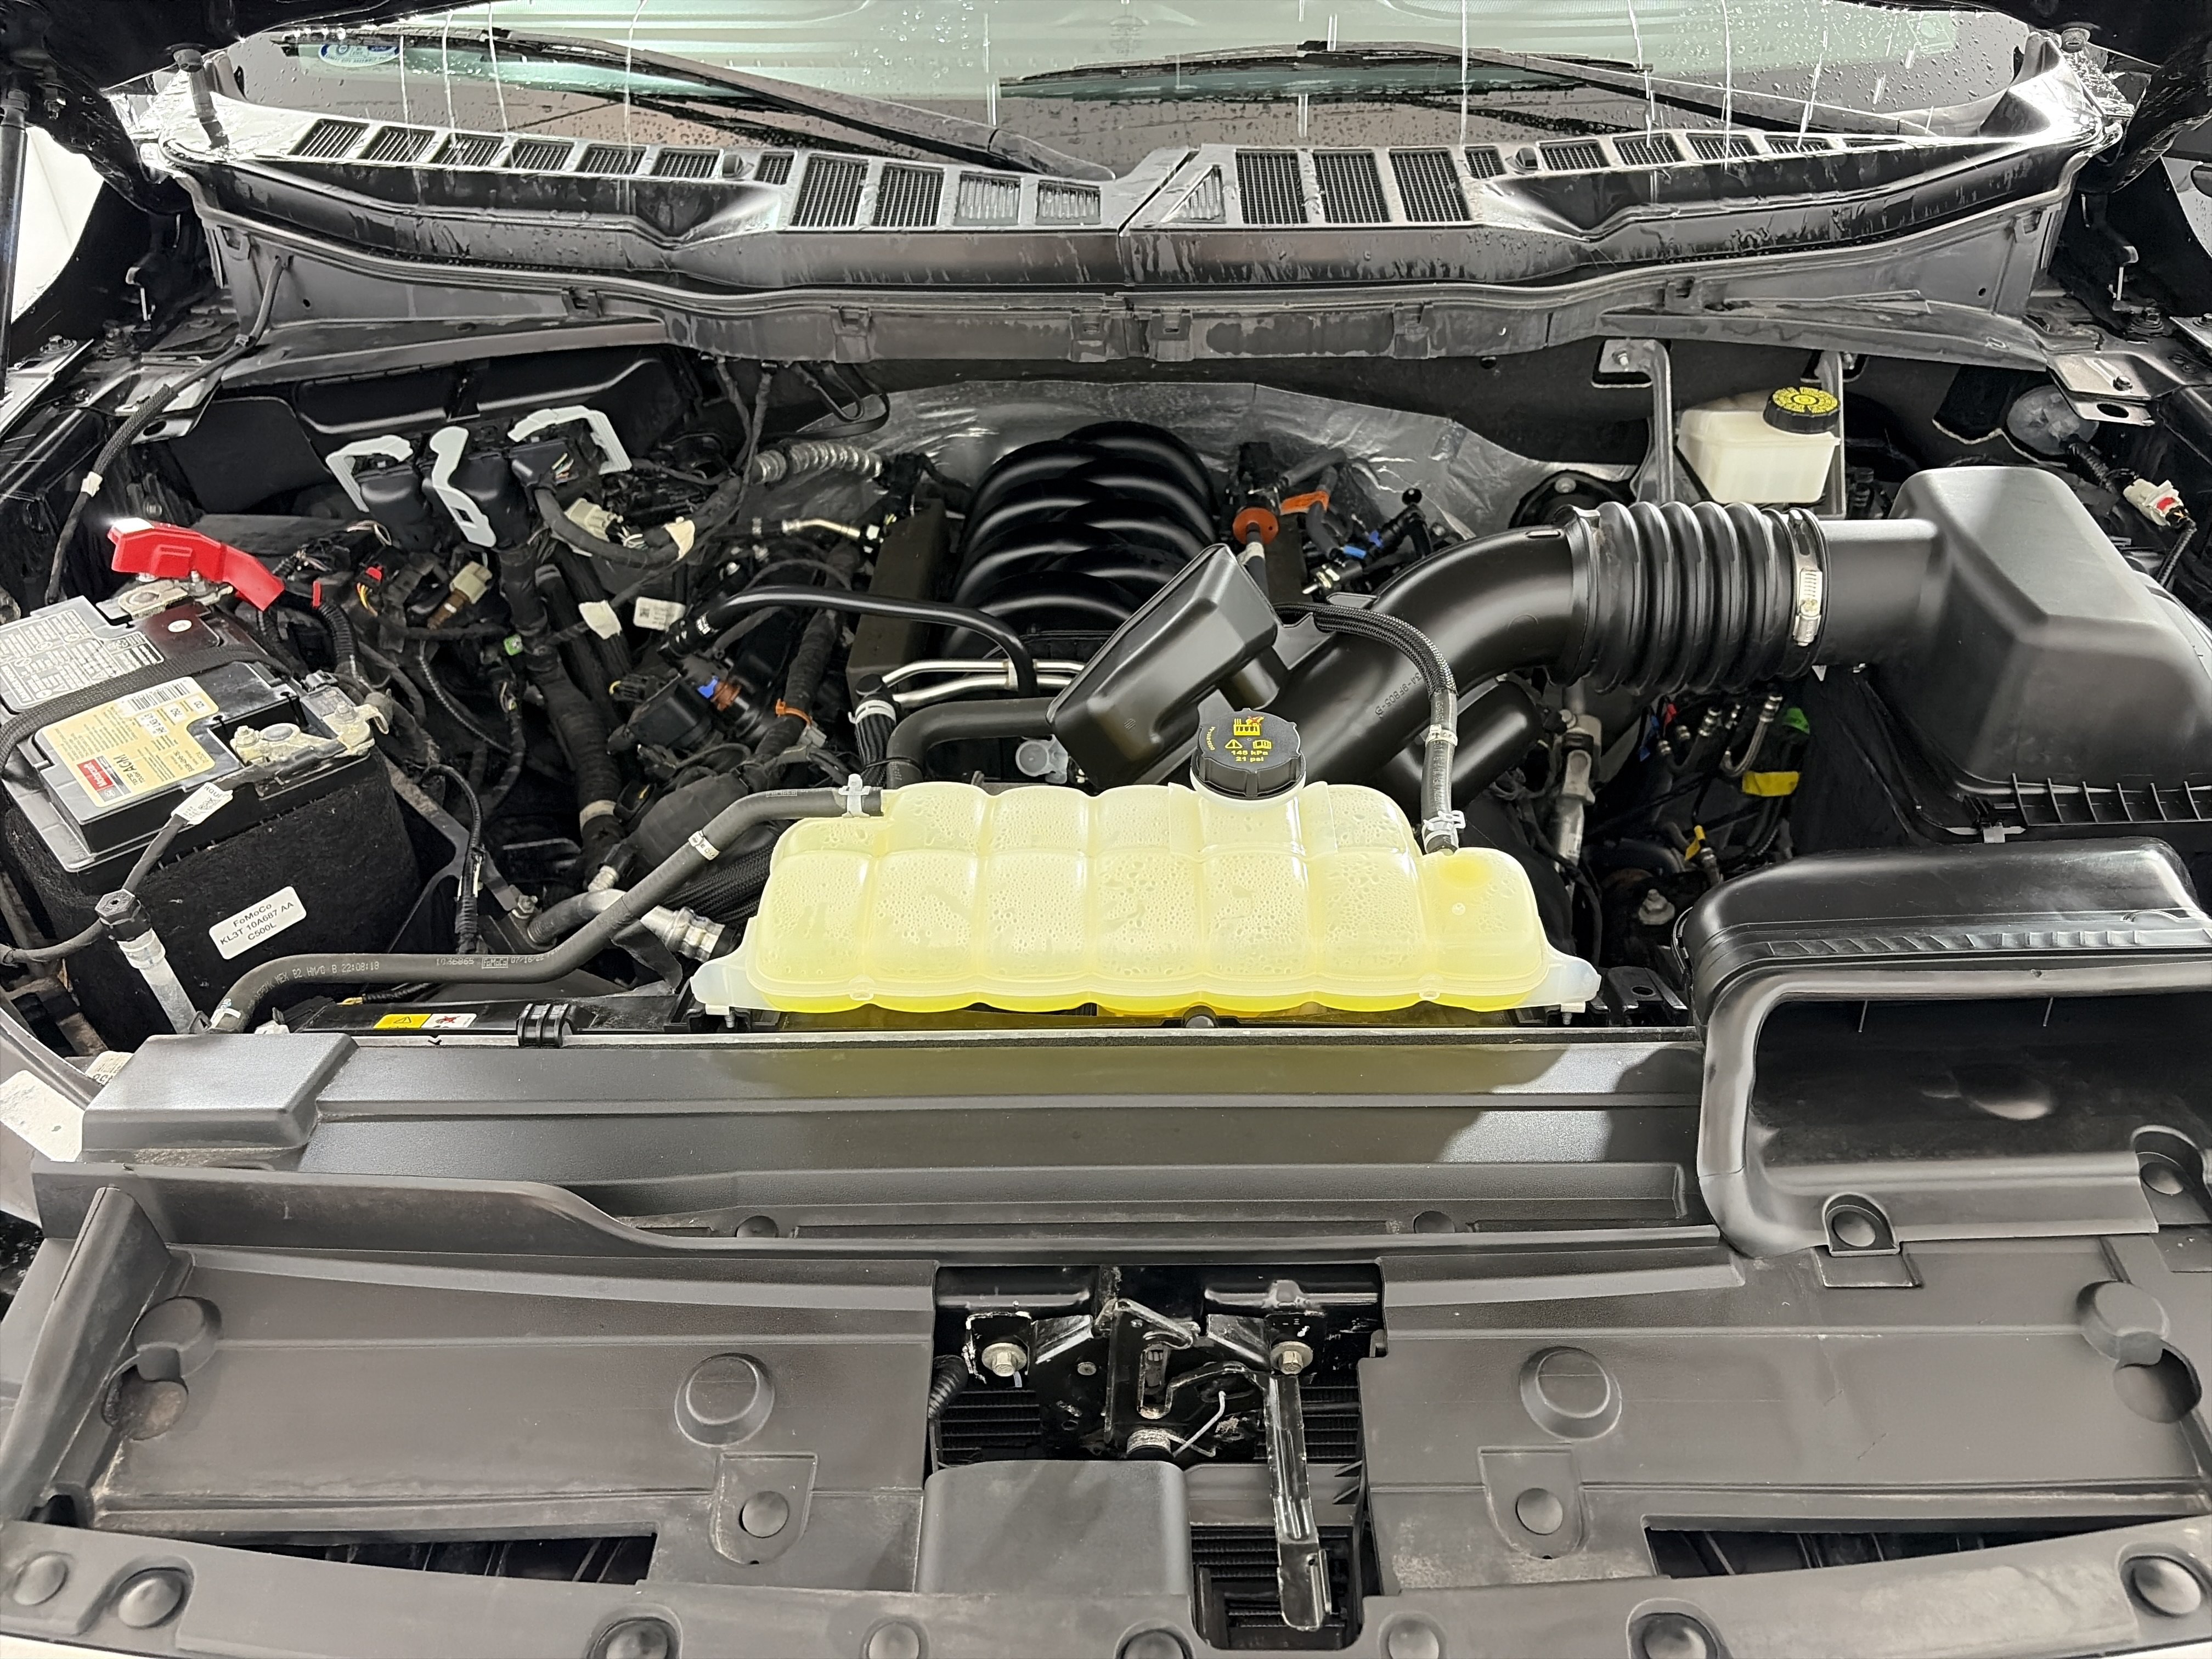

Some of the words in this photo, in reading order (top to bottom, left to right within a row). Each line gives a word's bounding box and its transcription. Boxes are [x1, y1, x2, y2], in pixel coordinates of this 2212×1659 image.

[113, 754, 137, 772] AGM
[83, 762, 108, 787] Motorcraft
[219, 928, 245, 945] KL3T
[246, 909, 278, 930] 10A687
[280, 901, 295, 912] AA
[233, 903, 272, 928] FoMoCo
[247, 922, 277, 941] C500L
[482, 957, 508, 967] FoMoCo
